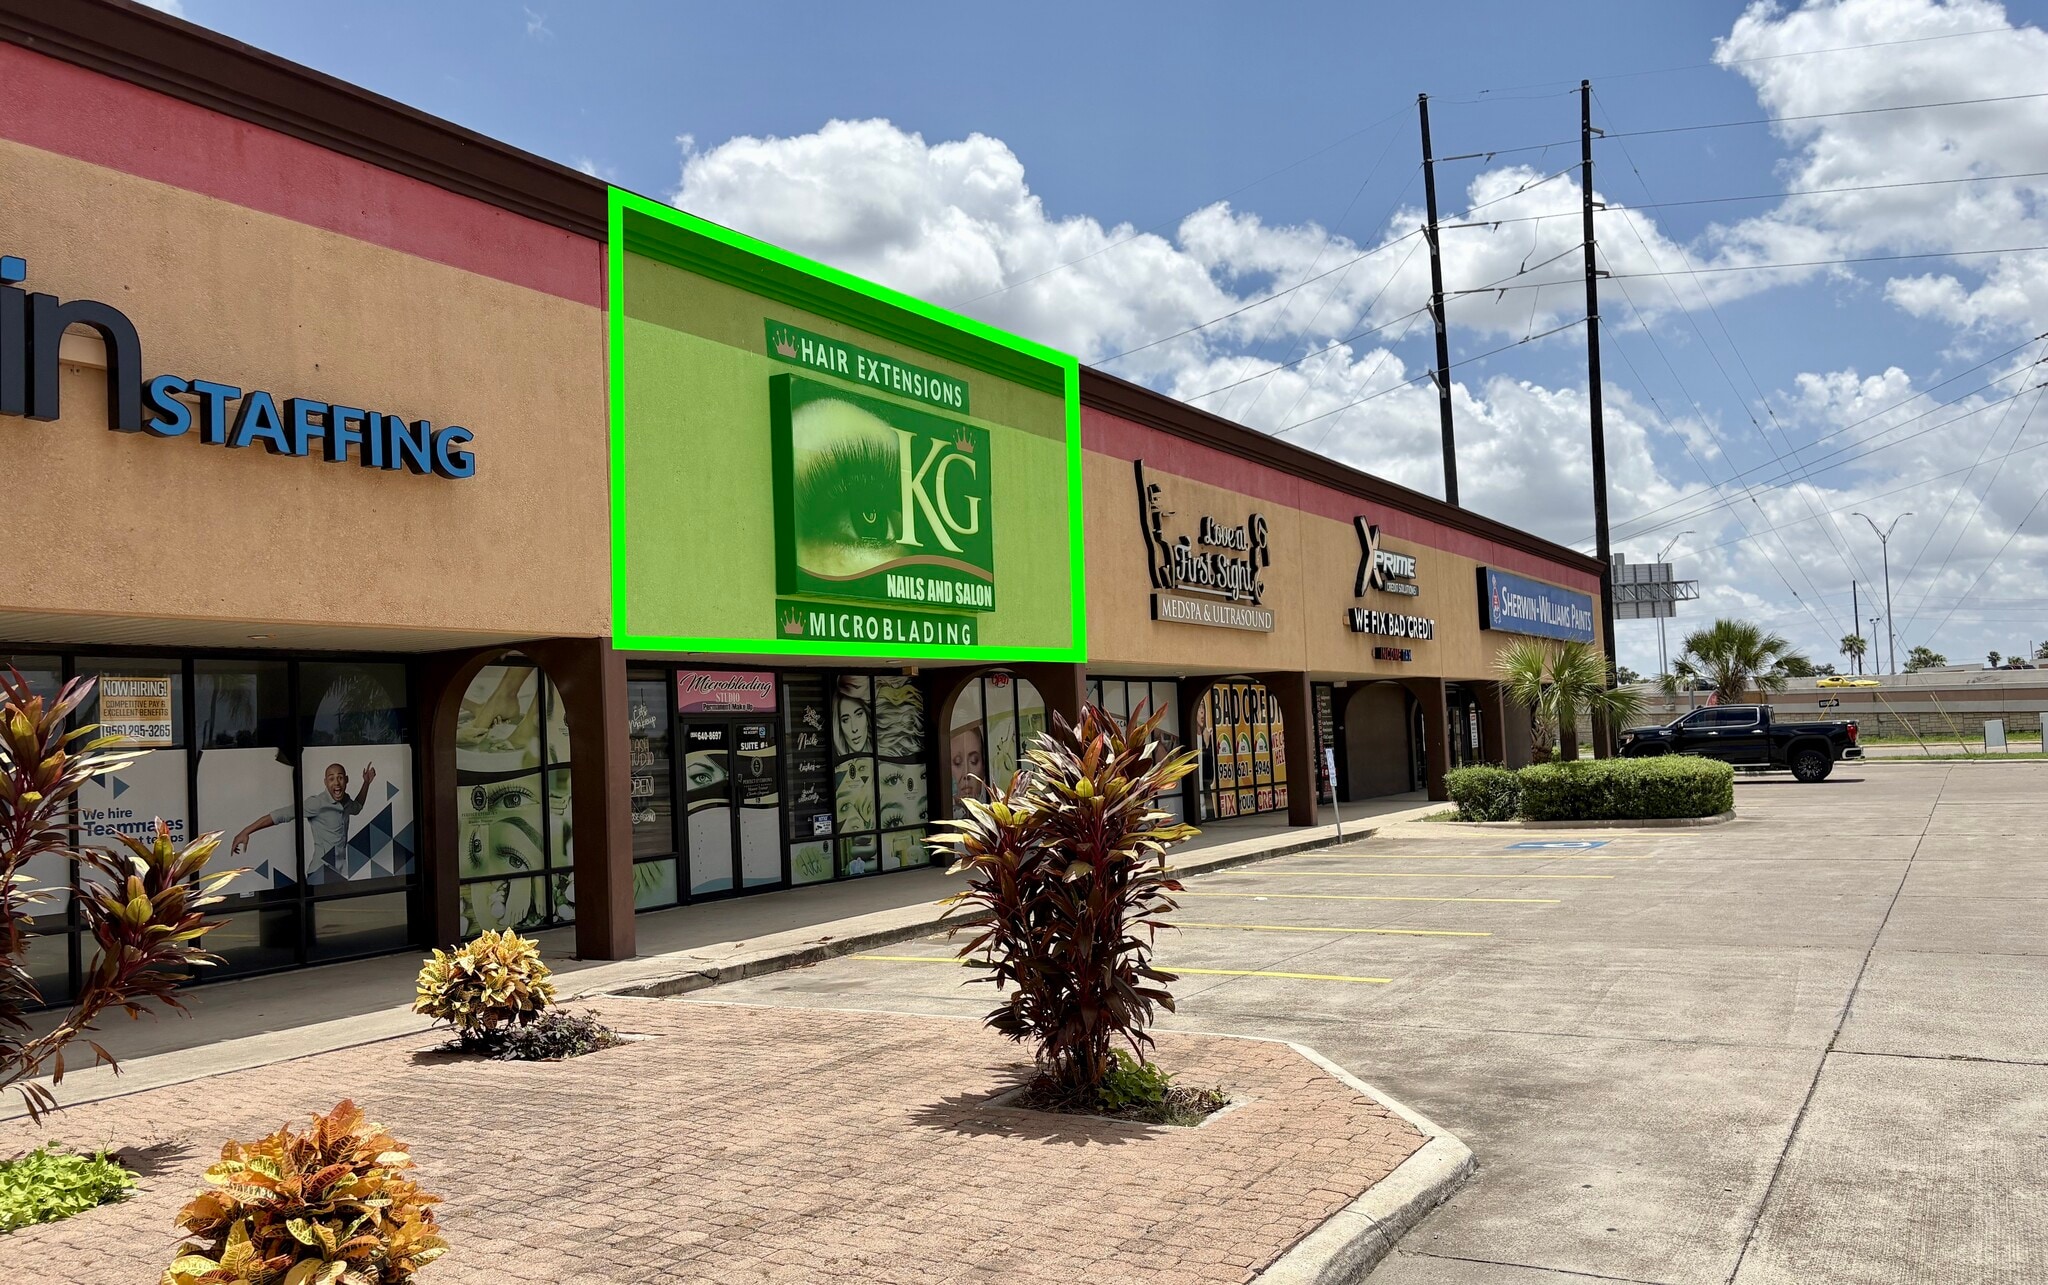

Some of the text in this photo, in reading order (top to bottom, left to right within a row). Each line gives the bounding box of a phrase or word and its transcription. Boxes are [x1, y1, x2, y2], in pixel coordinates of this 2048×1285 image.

[801, 338, 963, 408] HAIR EXTENSIONS
[143, 374, 476, 479] STAFFING
[889, 425, 982, 553] KG
[1200, 516, 1236, 547] Love
[1175, 536, 1255, 600] First Sight
[886, 573, 993, 607] NAILS AND SALON
[1162, 599, 1272, 629] MEDSPA & ULTRASOUND
[1501, 586, 1592, 632] SHERWIN-WILLIAMS PAINTS
[809, 612, 971, 646] MICROBLADING
[1354, 607, 1435, 640] WE FIX BAD CREDIT
[1380, 647, 1402, 661] INCOME
[103, 680, 168, 697] NOW HIRING!
[679, 672, 772, 699] Microblading
[715, 693, 740, 703] STUDIO
[103, 708, 169, 717] EXCELLENT BENEFITS
[105, 700, 166, 708] COMPETITIVE PAY &
[731, 703, 746, 711] Make
[746, 704, 754, 712] Up
[1213, 688, 1240, 725] BAD
[1243, 688, 1282, 724] CREDI
[129, 724, 171, 738] 295-3265
[629, 751, 655, 766] TUDIO
[740, 741, 759, 750] SUITE
[82, 808, 133, 821] We hire
[1220, 794, 1236, 816] FIX
[1257, 788, 1287, 811] CREDIT
[83, 819, 184, 837] Teammaes
[146, 834, 185, 844] teps
